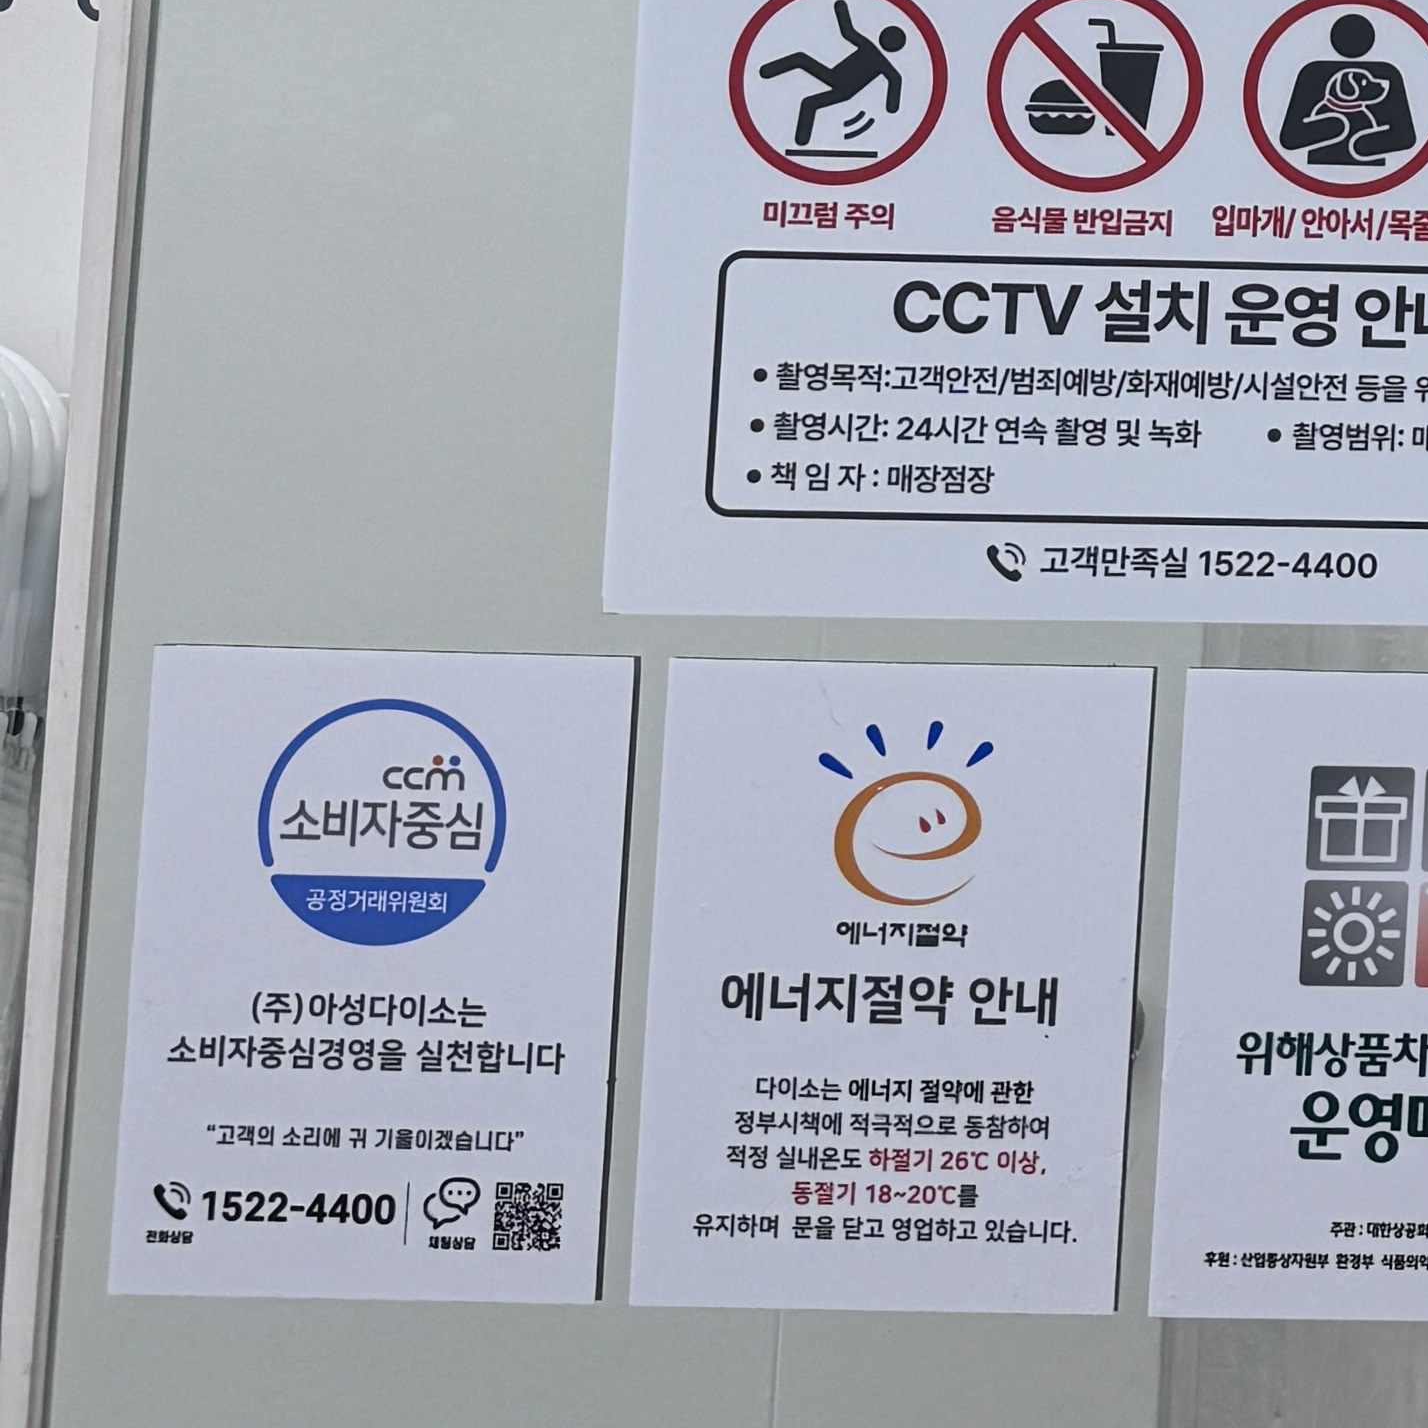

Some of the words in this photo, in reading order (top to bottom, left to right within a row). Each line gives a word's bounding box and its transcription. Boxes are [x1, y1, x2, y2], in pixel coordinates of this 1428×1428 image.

[764, 201, 837, 228] 미끄럼
[845, 203, 894, 230] 주의
[992, 207, 1067, 234] 음식물
[1074, 208, 1172, 236] 반입금지
[894, 281, 1083, 335] CCTV
[1095, 280, 1209, 344] 설치
[1225, 284, 1339, 347] 운영
[1356, 375, 1407, 402] 등을
[774, 412, 888, 442] 촬영시간:
[897, 415, 988, 443] 24시간
[995, 417, 1047, 445] 연속
[1055, 417, 1106, 446] 촬영
[1117, 419, 1139, 447] 및
[1149, 420, 1201, 448] 녹화
[1293, 422, 1404, 451] 촬영범위:
[888, 465, 995, 494] 매장점장
[1040, 546, 1187, 578] 고객만족실
[1200, 551, 1377, 578] 1522-4400
[383, 756, 465, 791] ccm
[280, 800, 483, 850] 소비자중심
[306, 889, 447, 913] 공정거래위원회
[837, 922, 968, 947] 에너지절약
[722, 972, 953, 1025] 에너지절약
[970, 977, 1058, 1026] 안내
[167, 1035, 406, 1071] 소비자중심경영을
[417, 1040, 565, 1075] 실천합니다
[756, 1077, 841, 1100] 다이소는
[849, 1078, 912, 1103] 에너지
[920, 1079, 984, 1104] 절약에
[991, 1081, 1034, 1104] 관한
[283, 1127, 340, 1148] 소리에
[349, 1128, 366, 1148] 귀
[735, 1111, 842, 1135] 정부시책에
[850, 1113, 957, 1137] 적극적으로
[964, 1115, 1049, 1139] 동참하여
[727, 1145, 767, 1169] 적정
[777, 1146, 861, 1170] 실내온도
[869, 1148, 932, 1172] 하절기
[998, 1151, 1045, 1175] 이상,
[203, 1191, 395, 1224] 1522-4400
[792, 1182, 855, 1205] 동절기
[693, 1214, 778, 1238] 유지하며
[792, 1216, 835, 1239] 문을
[843, 1217, 884, 1240] 닫고
[892, 1218, 977, 1241] 영업하고
[985, 1220, 1076, 1244] 있습니다.
